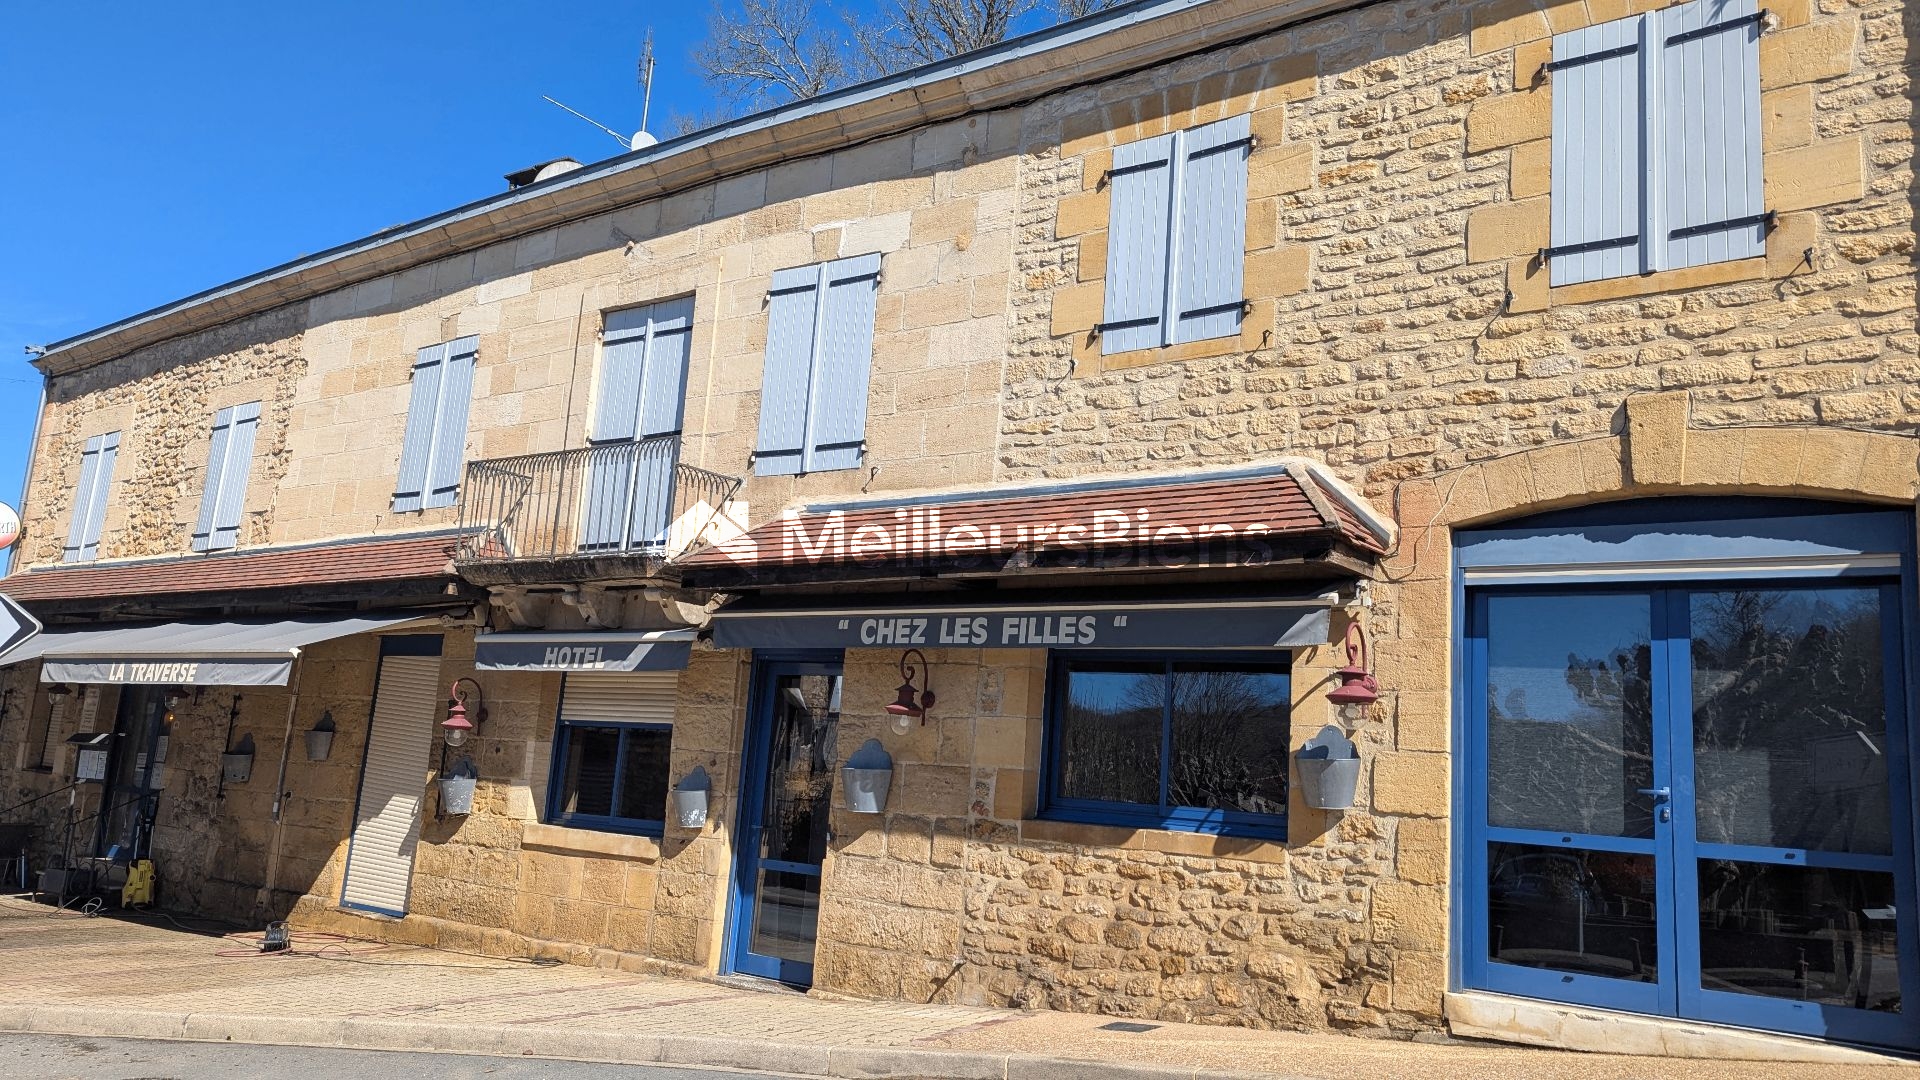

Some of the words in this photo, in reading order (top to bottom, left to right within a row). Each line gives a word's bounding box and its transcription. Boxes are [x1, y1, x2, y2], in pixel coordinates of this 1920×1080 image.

[860, 618, 928, 645] CHEZ
[939, 617, 988, 645] LES
[1002, 615, 1096, 645] FILLES
[543, 646, 605, 669] HOTEL
[109, 662, 124, 681] LA
[130, 662, 198, 682] TRAVERSE
